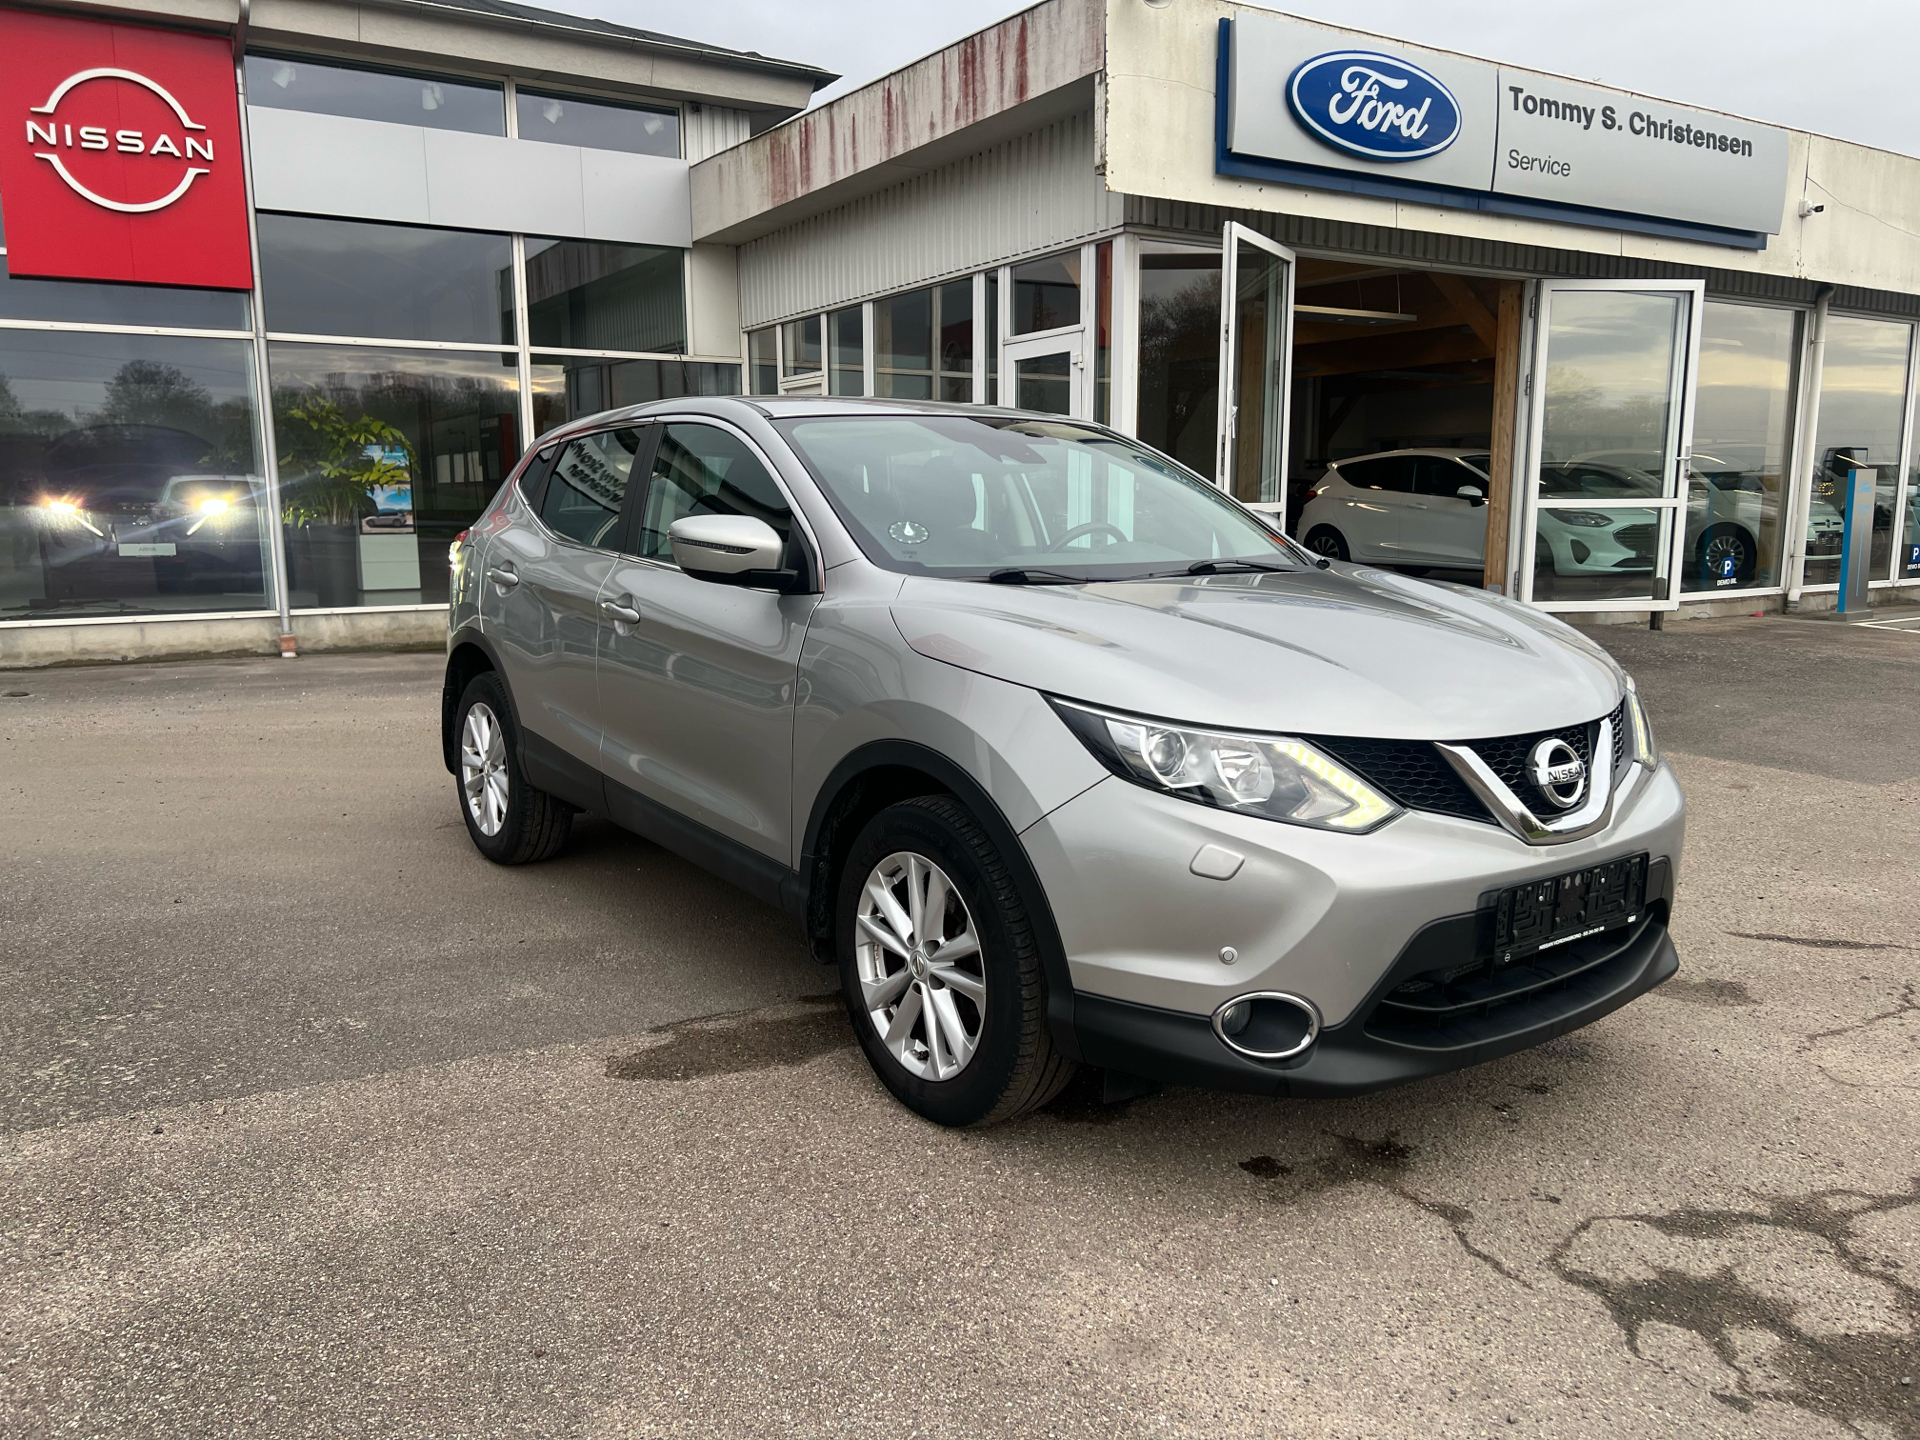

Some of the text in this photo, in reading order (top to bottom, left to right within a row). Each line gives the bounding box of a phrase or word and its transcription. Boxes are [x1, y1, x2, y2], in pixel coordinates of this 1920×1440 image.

[1329, 66, 1432, 139] Ford
[1508, 86, 1753, 157] Tommy S. Christensen
[26, 120, 214, 161] NISSAN
[1508, 149, 1571, 177] Service
[1724, 560, 1731, 575] P
[894, 819, 947, 848] PRIMACY
